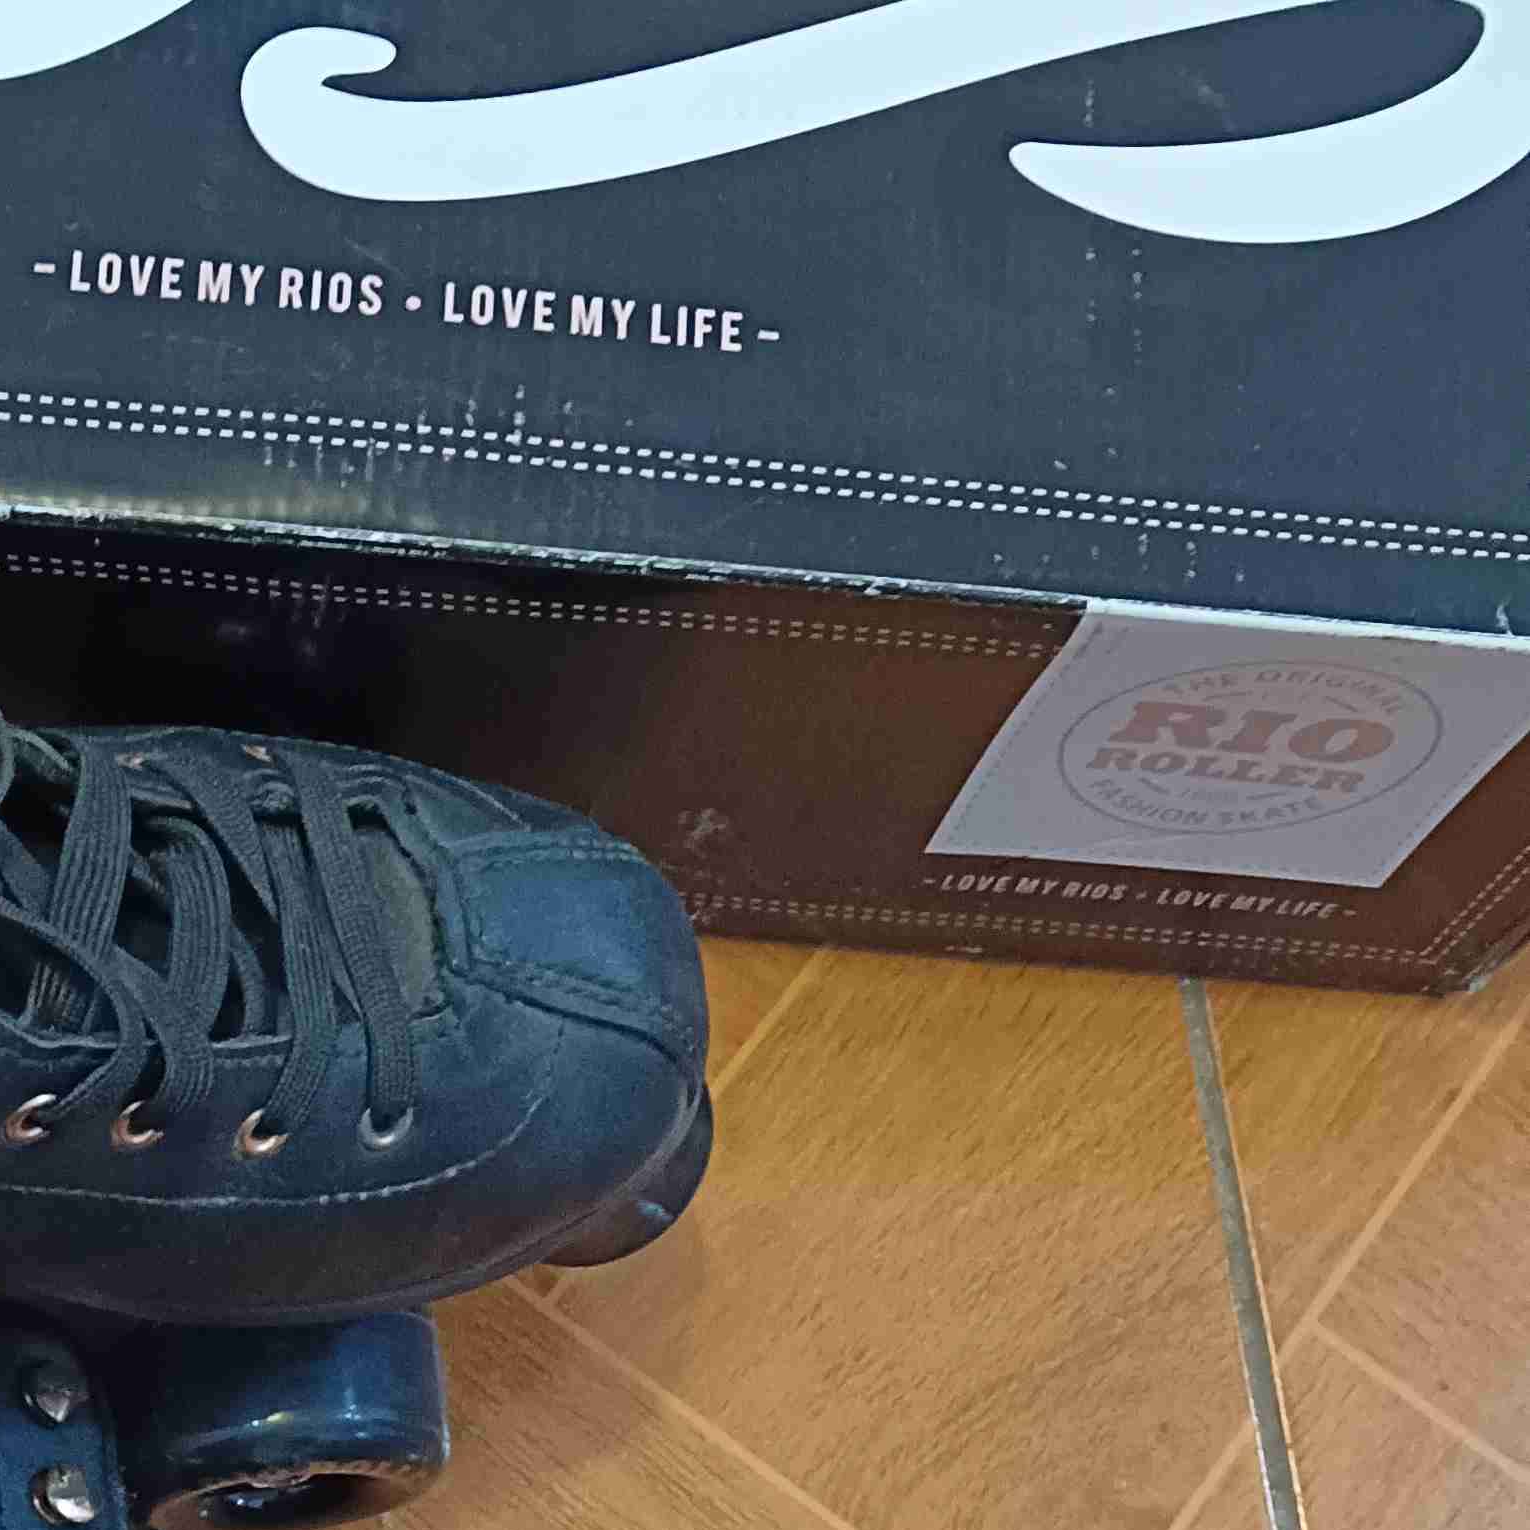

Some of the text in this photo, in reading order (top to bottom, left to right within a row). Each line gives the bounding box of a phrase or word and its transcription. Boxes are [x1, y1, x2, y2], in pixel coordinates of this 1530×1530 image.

[70, 249, 384, 316] LOVE MY RIOS
[444, 281, 743, 352] LOVE MY LIFE
[1108, 700, 1395, 762] RIO
[1087, 747, 1365, 793] ROLLER
[941, 874, 1127, 900] LOVE MY RIOS
[1157, 888, 1338, 919] LOVE MY LIFE
